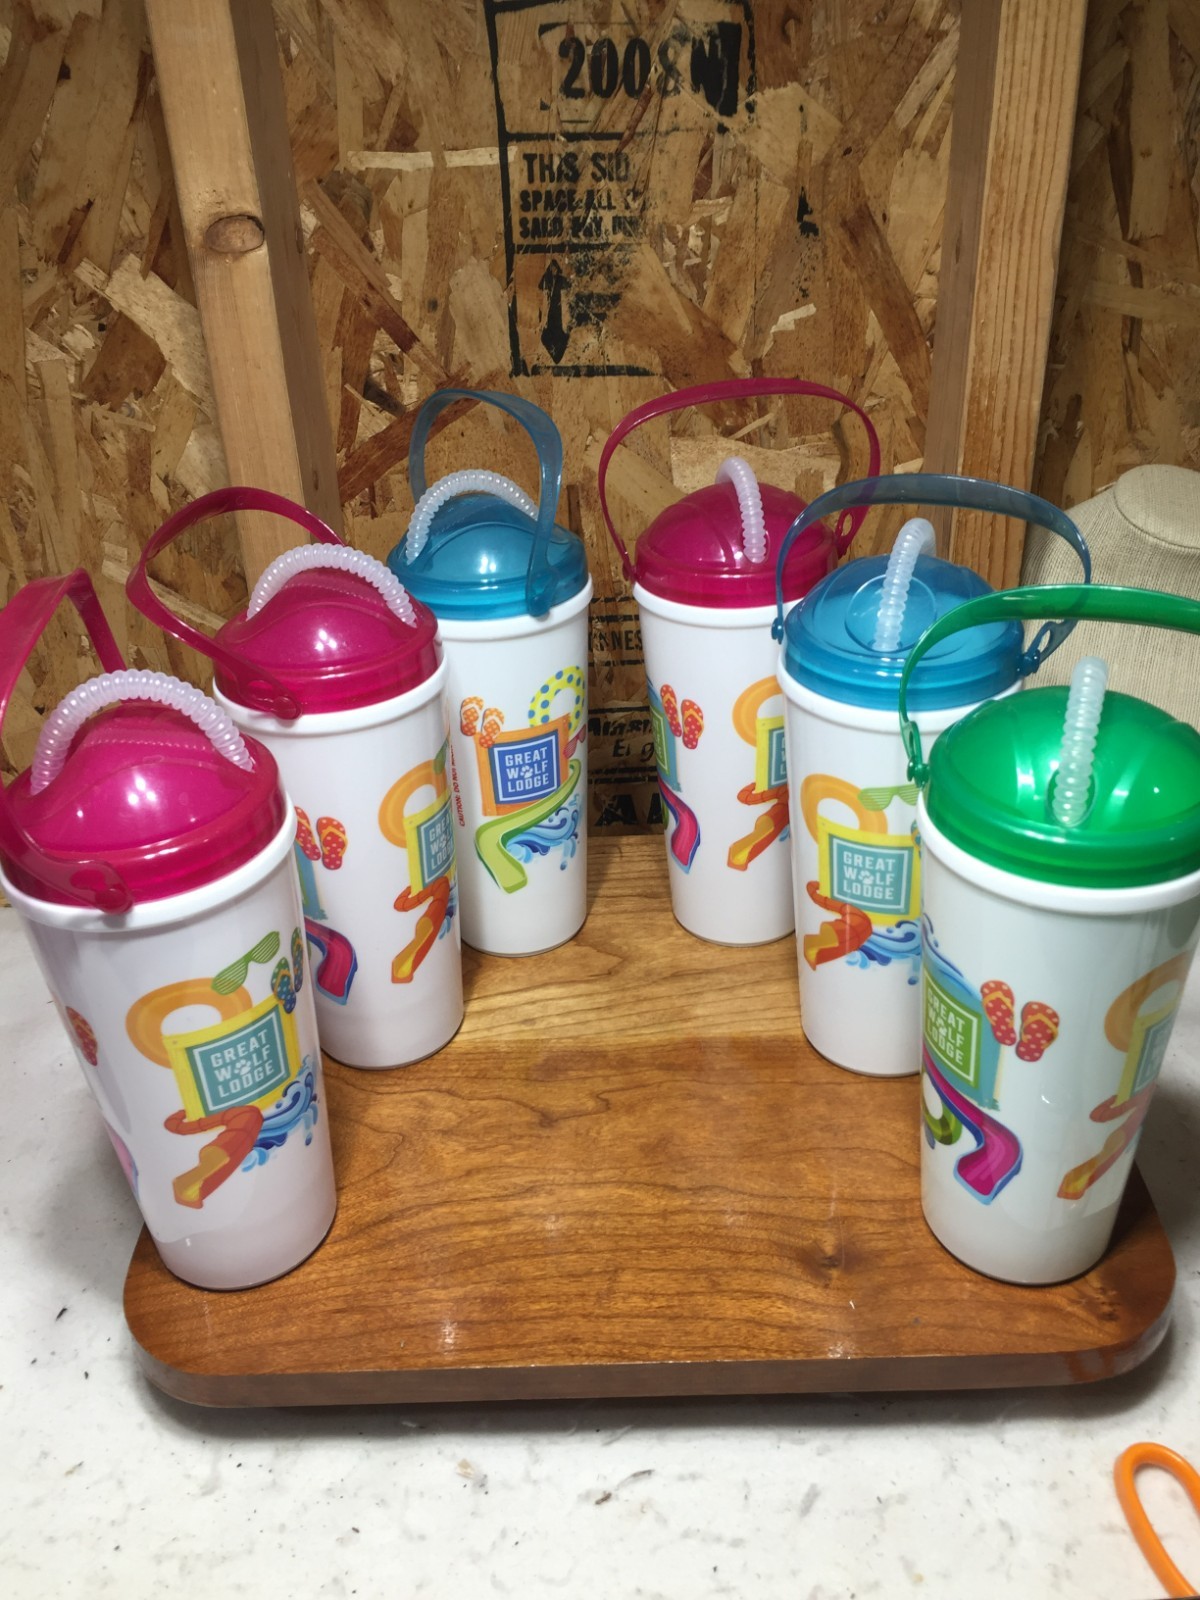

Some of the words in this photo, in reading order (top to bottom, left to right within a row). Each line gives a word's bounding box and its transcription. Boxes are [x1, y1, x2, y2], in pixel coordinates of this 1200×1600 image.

[522, 152, 580, 184] THIS
[505, 746, 548, 767] GREAT
[507, 773, 550, 793] LODGE
[843, 851, 896, 871] GREAT
[843, 880, 895, 900] LODGE
[927, 986, 966, 1034] GREAT
[210, 1028, 268, 1068] GREAT
[927, 1018, 965, 1066] LODGE
[217, 1059, 275, 1098] LODGE
